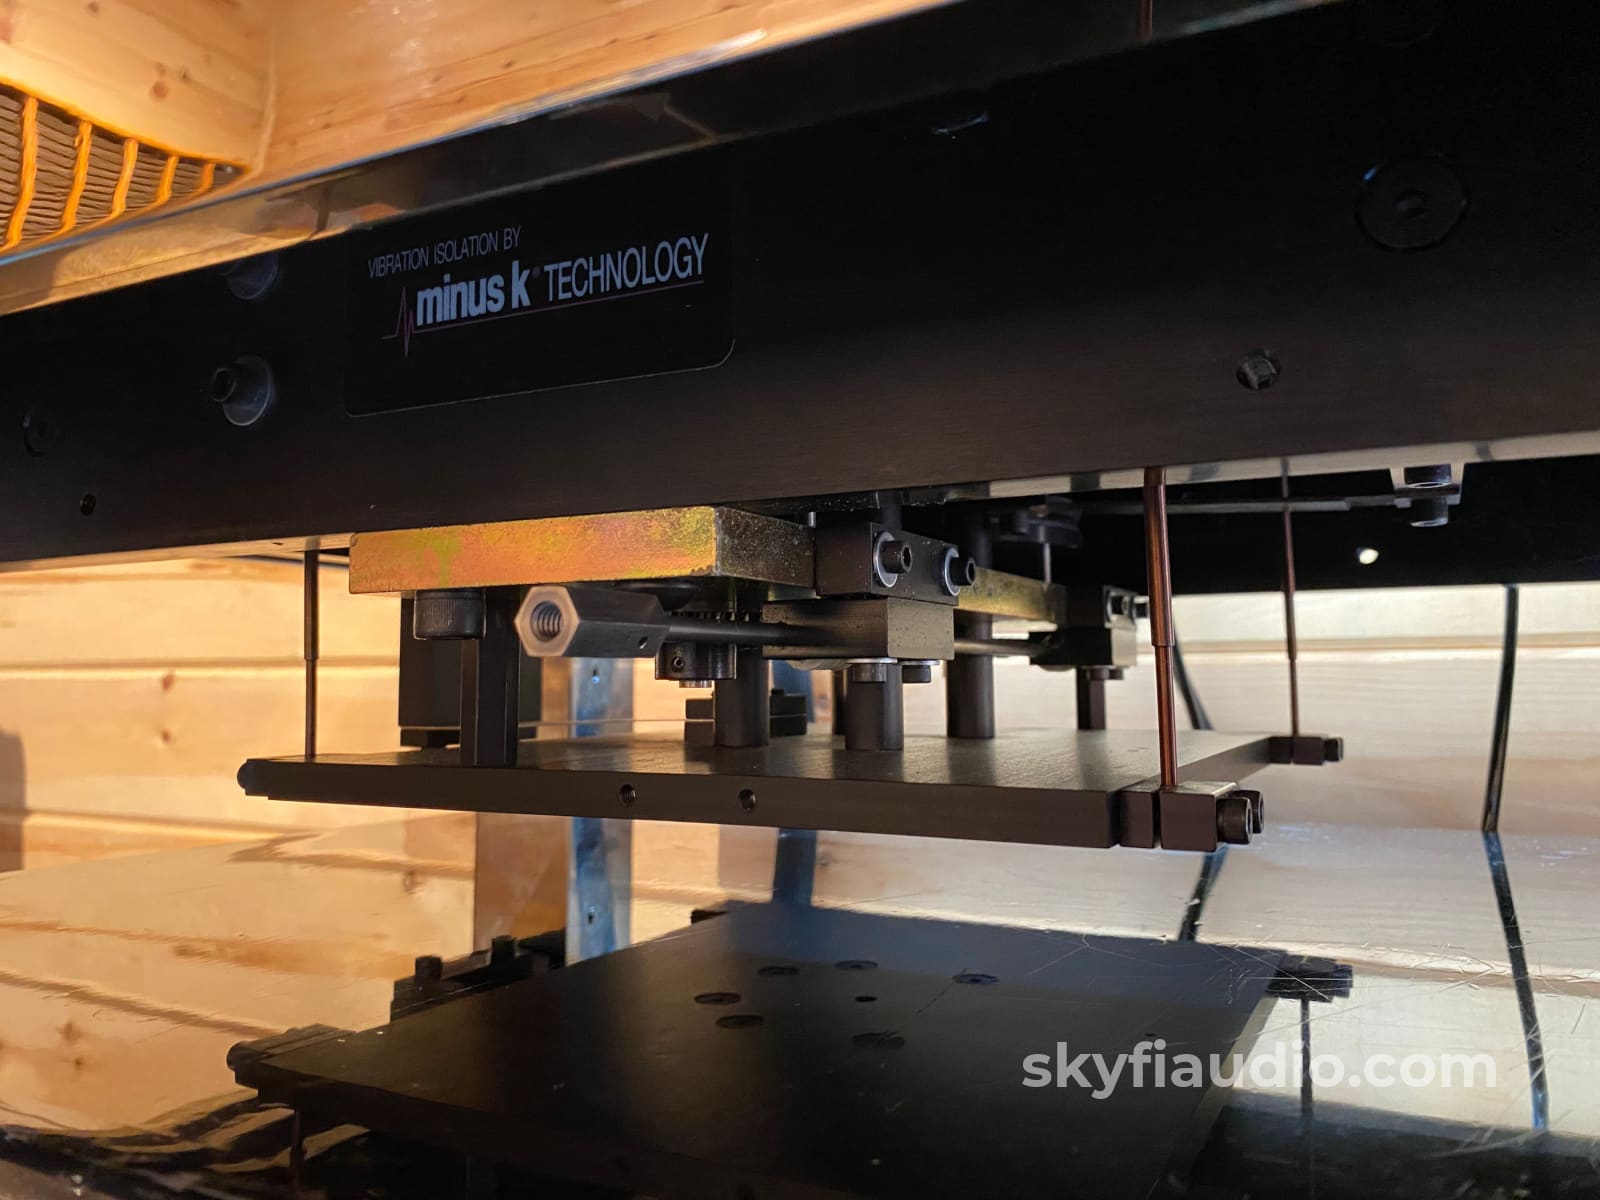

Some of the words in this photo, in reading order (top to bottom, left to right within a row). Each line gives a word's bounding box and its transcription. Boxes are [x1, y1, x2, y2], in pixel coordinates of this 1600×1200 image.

[368, 246, 429, 279] VIBRATION
[433, 231, 498, 265] ISOLATION
[503, 226, 522, 249] BY
[416, 274, 505, 326] minus
[544, 233, 709, 302] TECHNOLOGY
